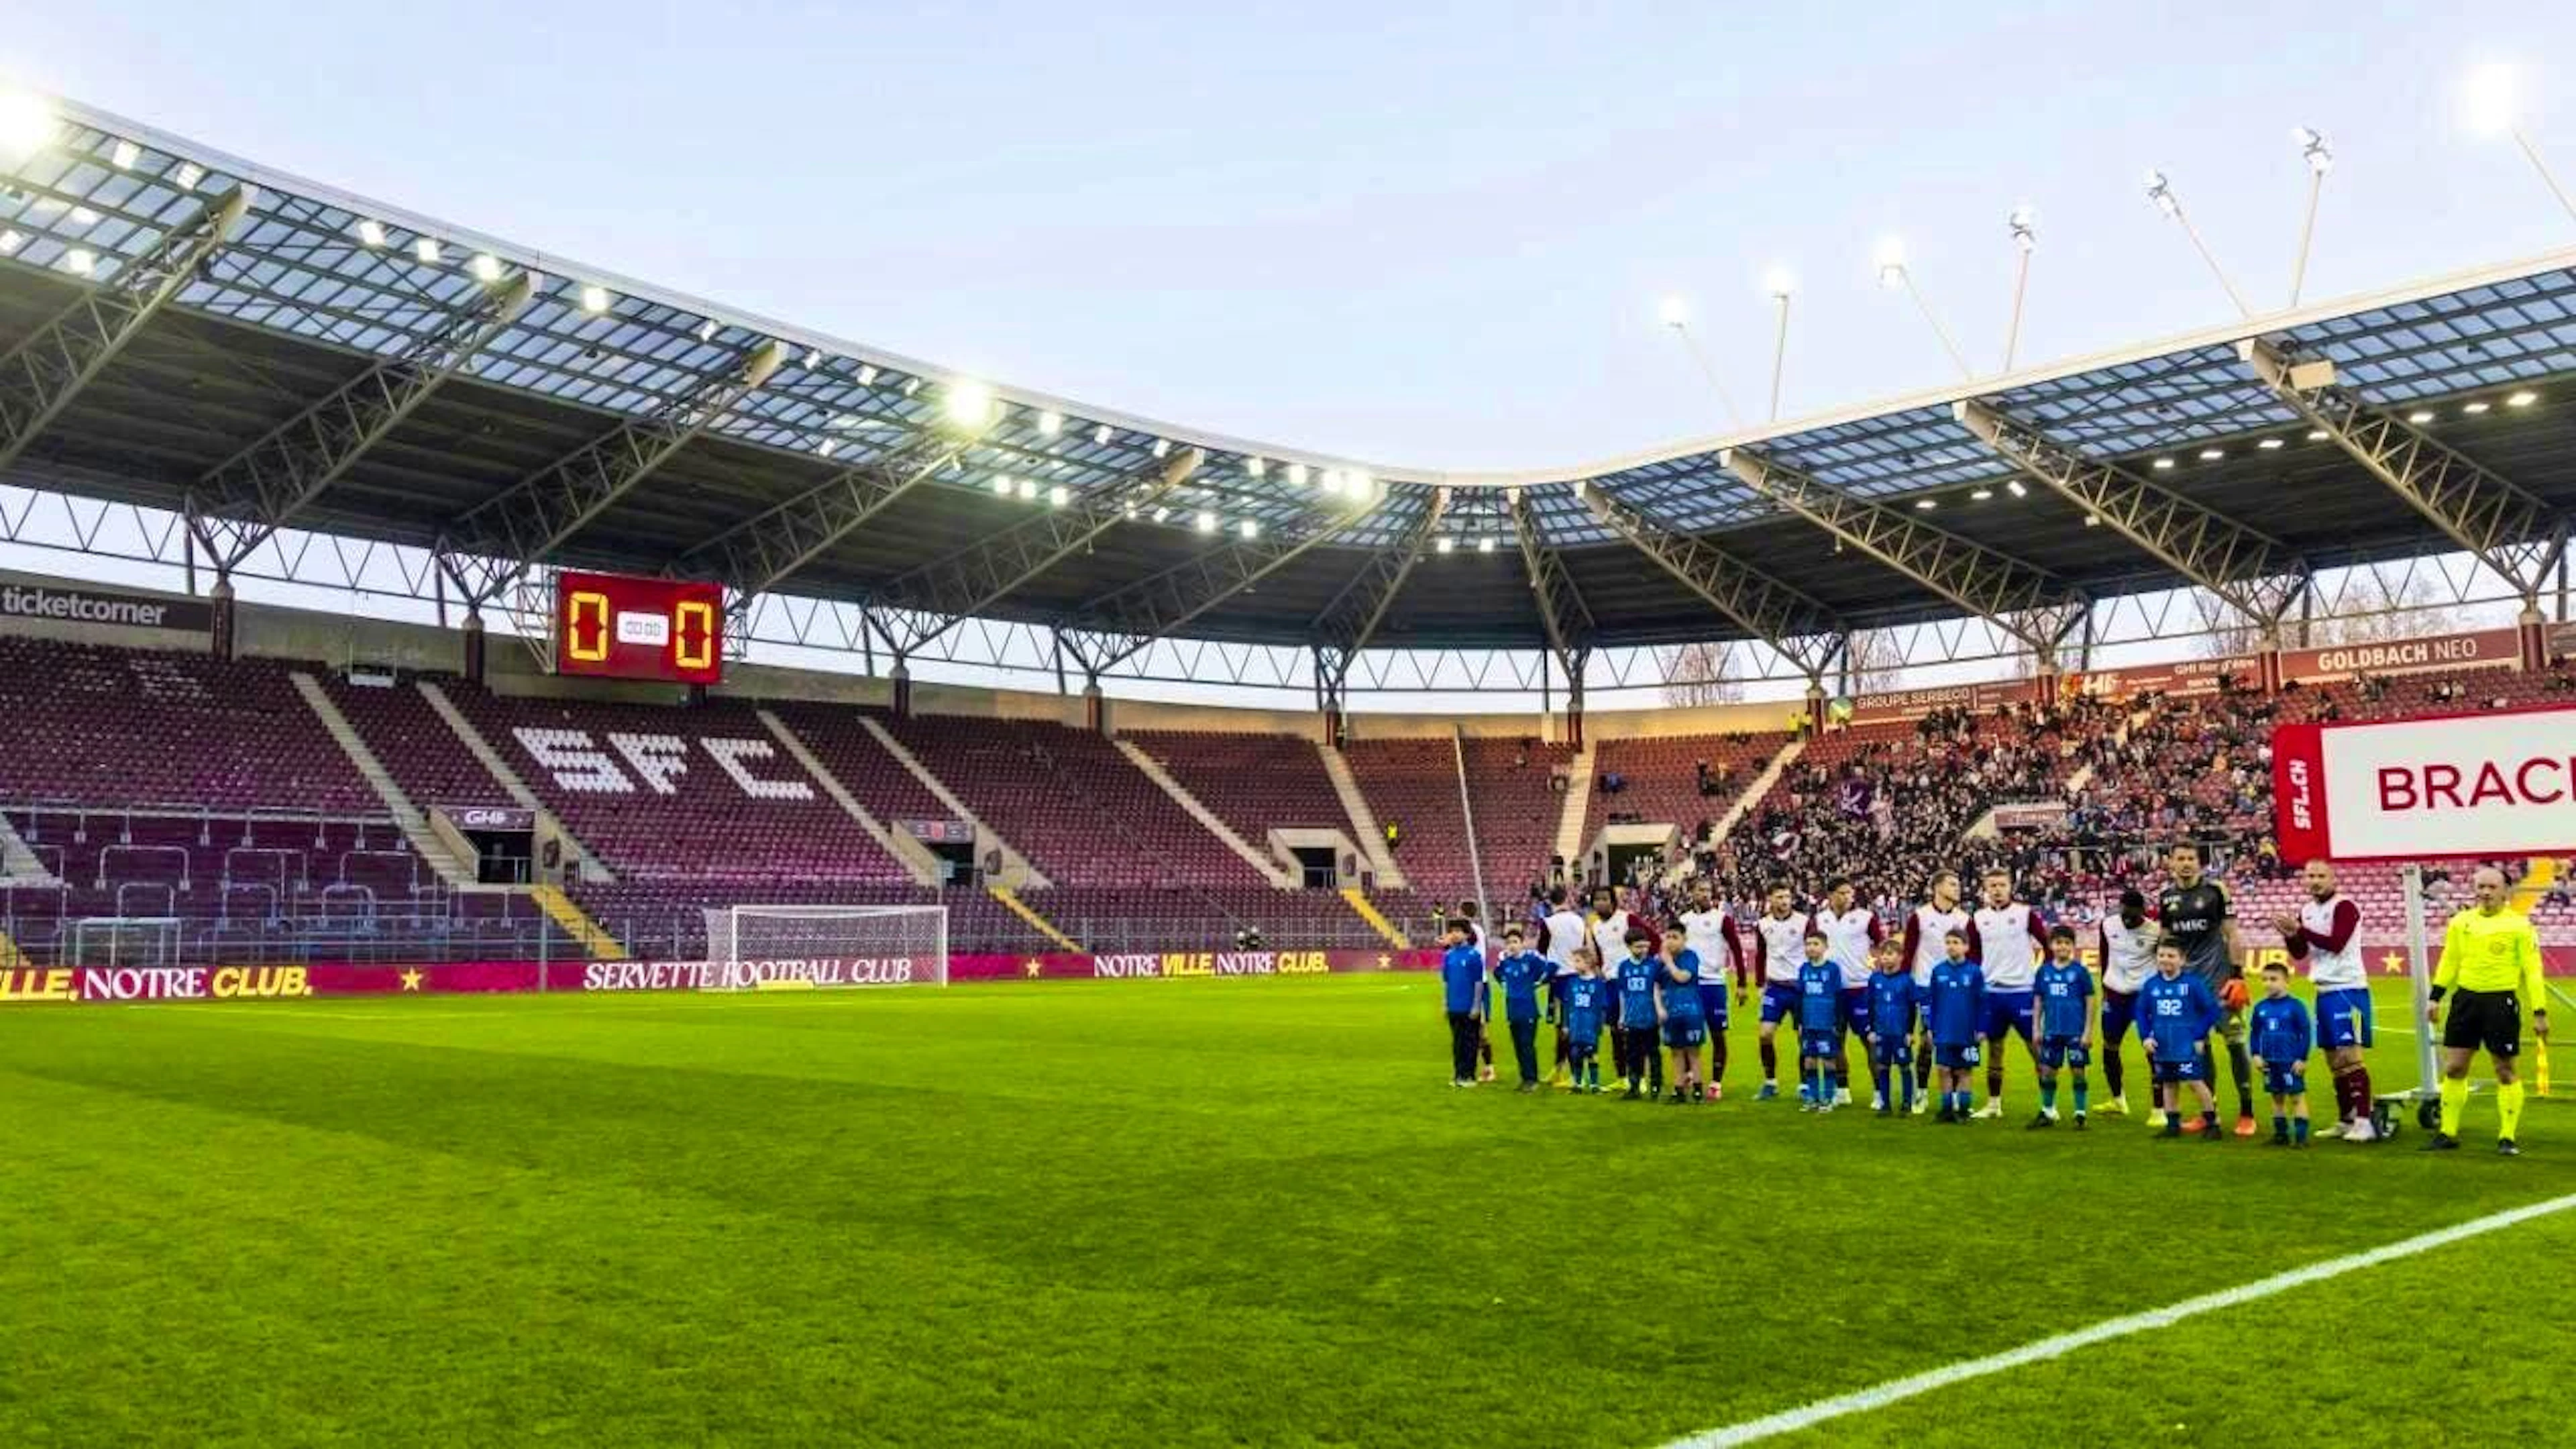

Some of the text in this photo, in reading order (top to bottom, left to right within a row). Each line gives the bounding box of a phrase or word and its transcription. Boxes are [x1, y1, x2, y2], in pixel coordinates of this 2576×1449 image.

[2, 586, 166, 625] ticketcorner
[570, 592, 608, 661] 0
[676, 602, 712, 669] 0
[2318, 638, 2477, 671] GOLDBACH NEO
[1857, 692, 1909, 709] GROUPE
[512, 727, 814, 800] SFC
[2288, 759, 2312, 830] SFL.CH
[583, 958, 910, 989] SERVETTE FOOTBALL CLUB
[1094, 955, 1159, 977] NOTRE
[1216, 951, 1275, 973] NOTRE
[1277, 952, 1329, 972] CLUB.
[83, 967, 207, 999] NOTRE
[212, 967, 313, 996] CLUB.
